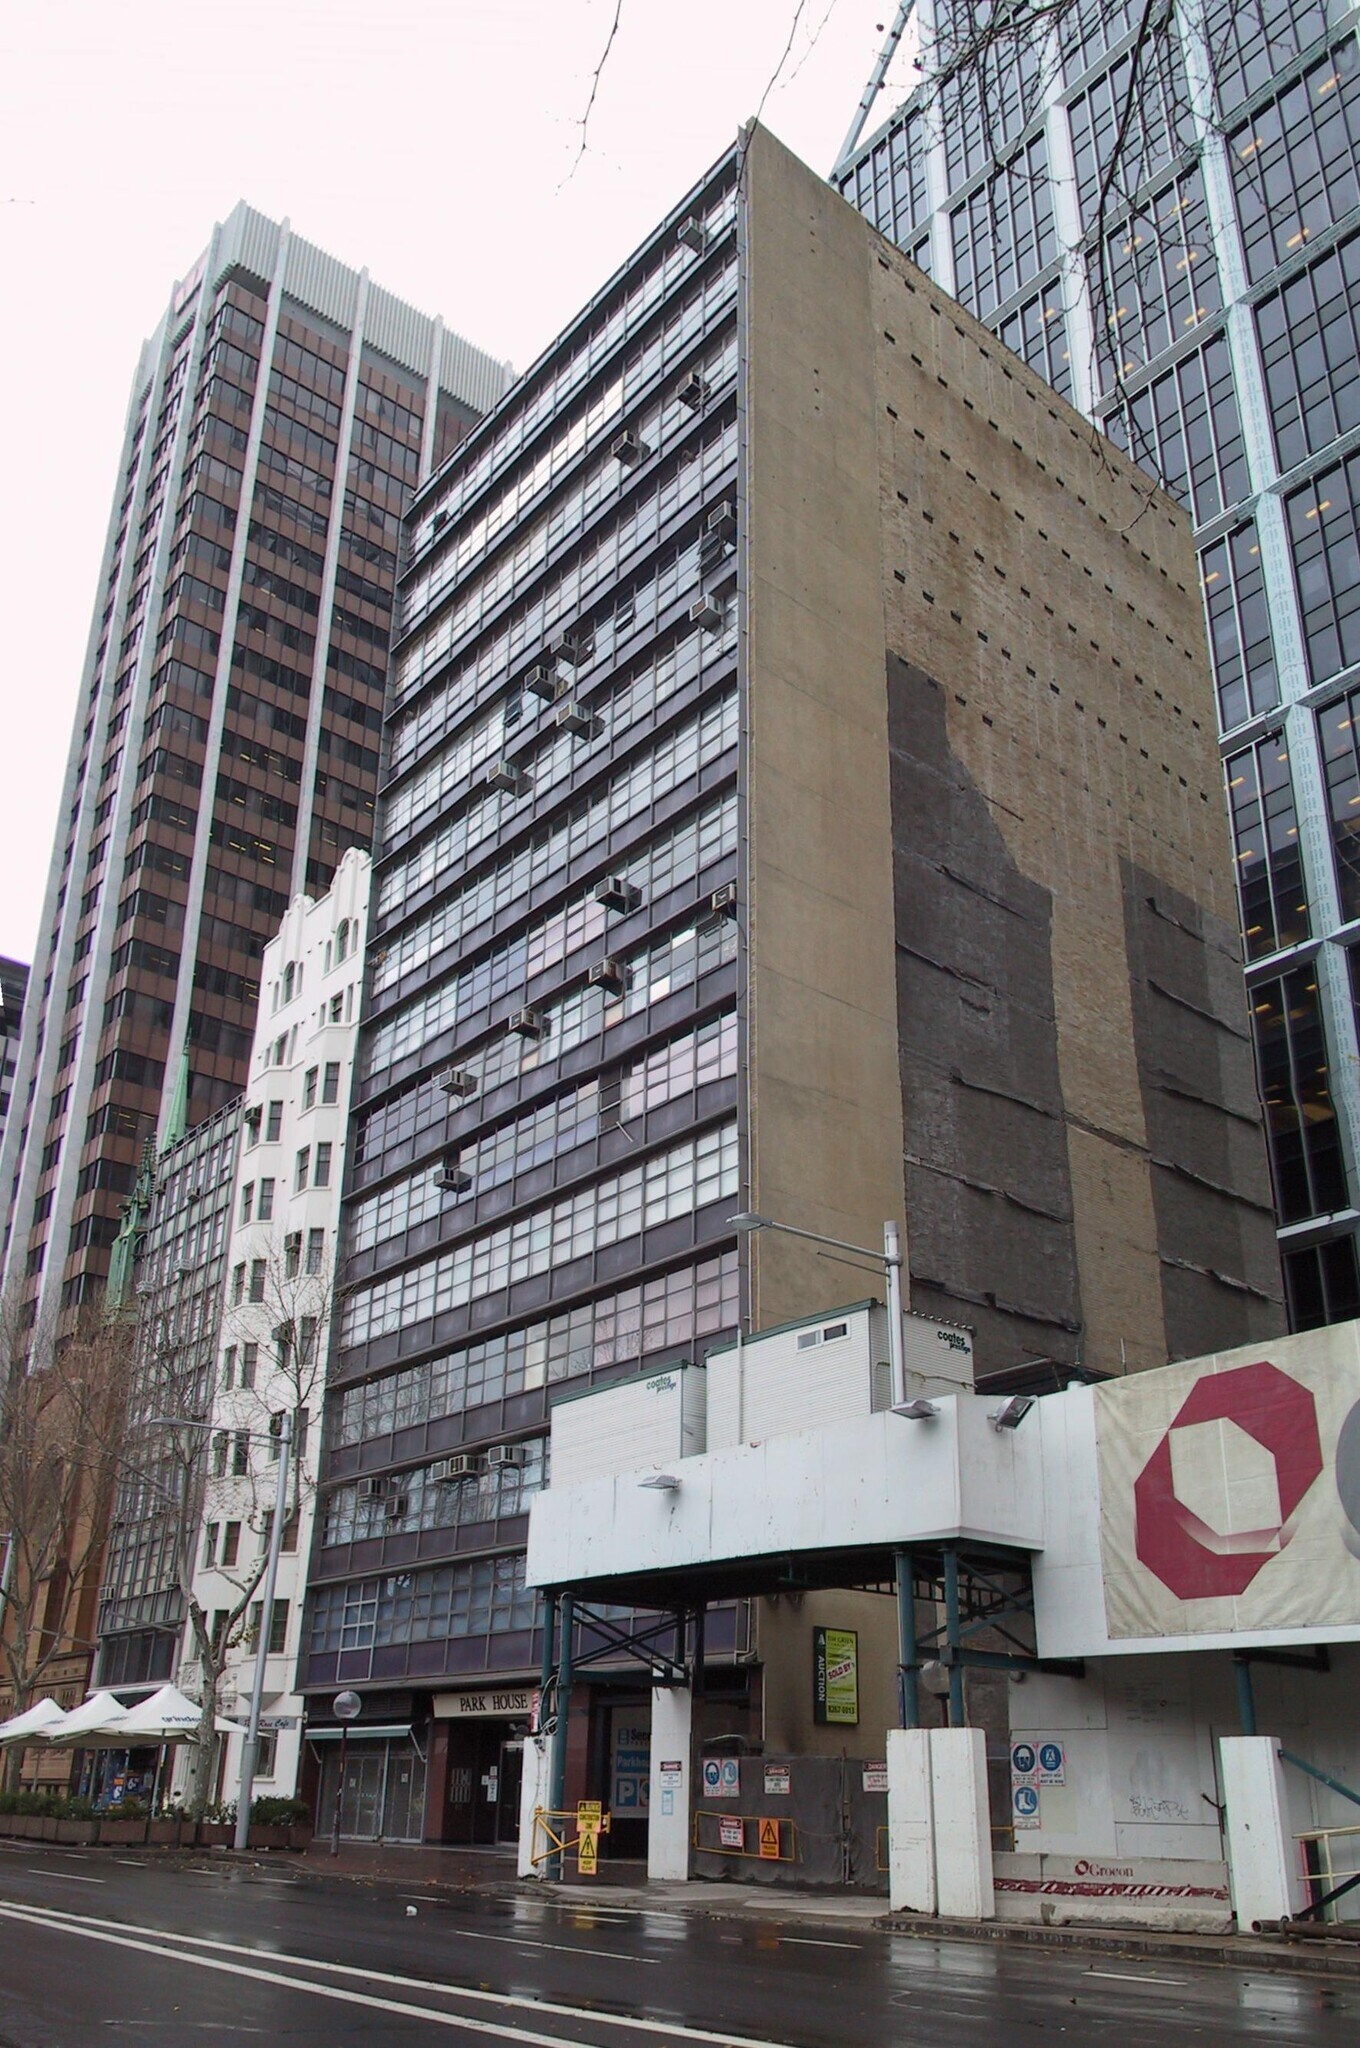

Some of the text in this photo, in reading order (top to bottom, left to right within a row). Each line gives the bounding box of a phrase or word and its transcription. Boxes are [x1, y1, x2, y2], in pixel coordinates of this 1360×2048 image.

[938, 1331, 965, 1346] coates
[646, 1376, 671, 1390] coates
[818, 1656, 826, 1702] AUCTION
[828, 1661, 852, 1680] SOLD BY
[460, 1694, 528, 1711] PARK HOUSE
